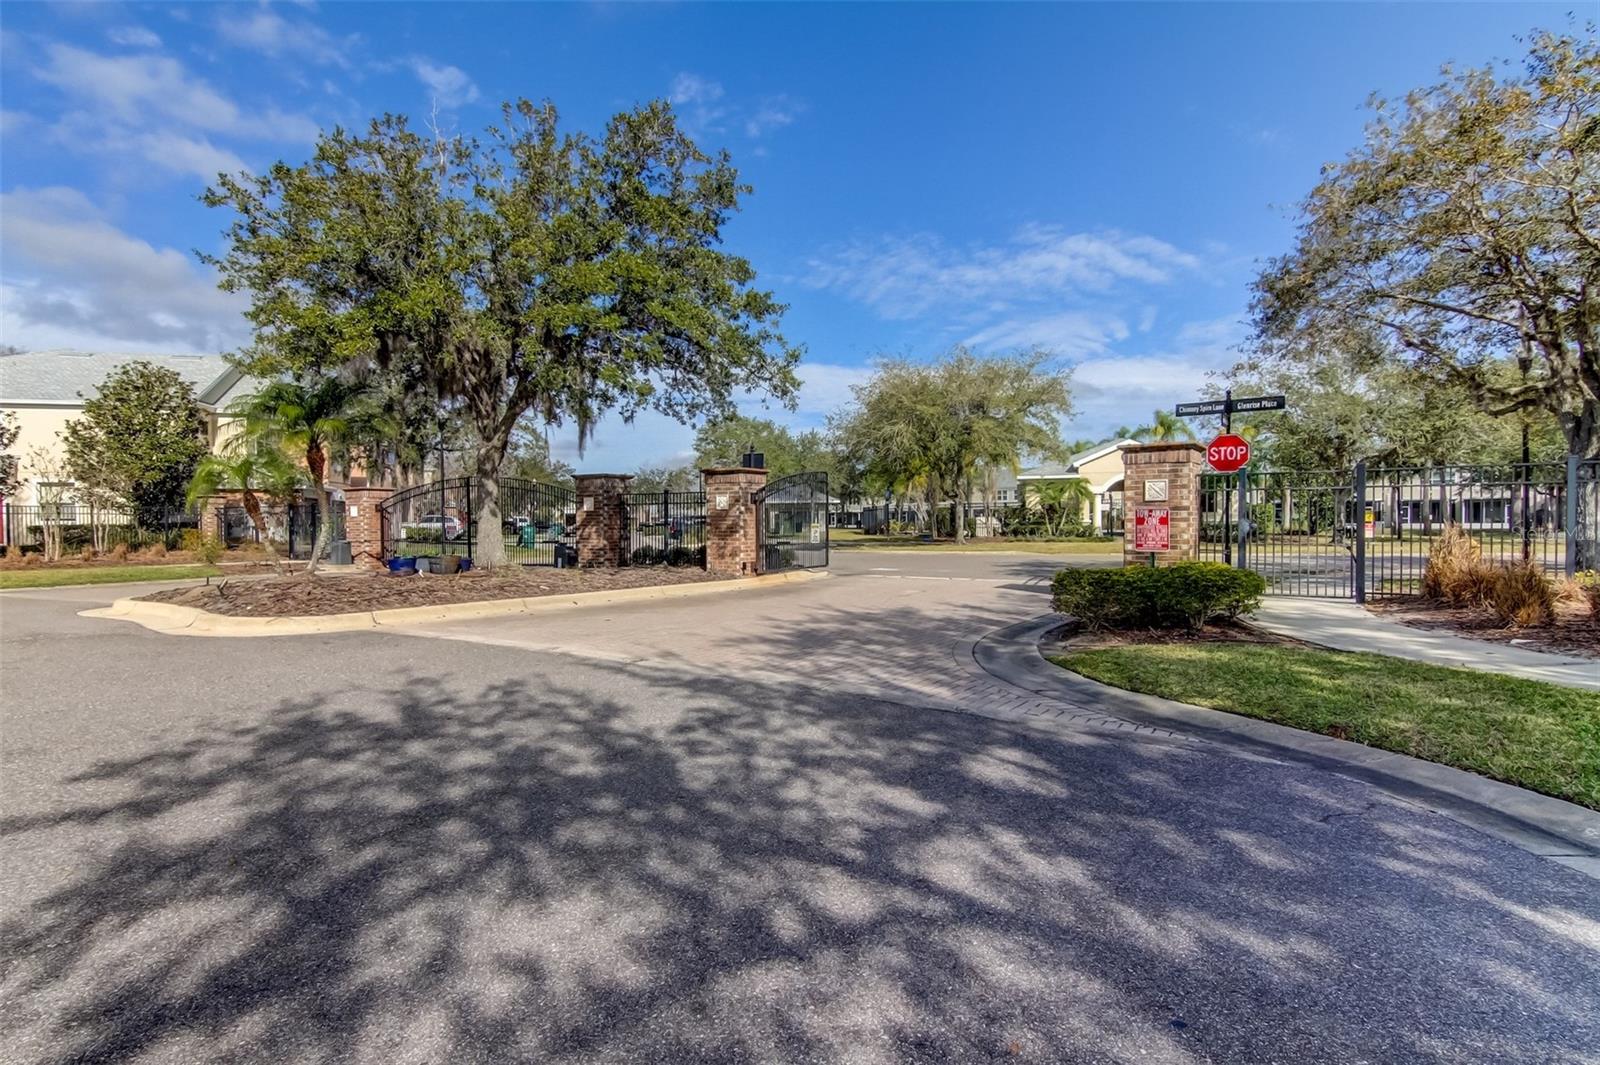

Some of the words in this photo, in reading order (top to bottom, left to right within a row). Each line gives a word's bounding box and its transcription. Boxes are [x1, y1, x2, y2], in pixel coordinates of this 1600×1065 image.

[1261, 400, 1277, 408] Place
[1209, 446, 1247, 461] STOP
[1136, 509, 1167, 518] TOW-AWAY
[1144, 517, 1160, 526] ZONE
